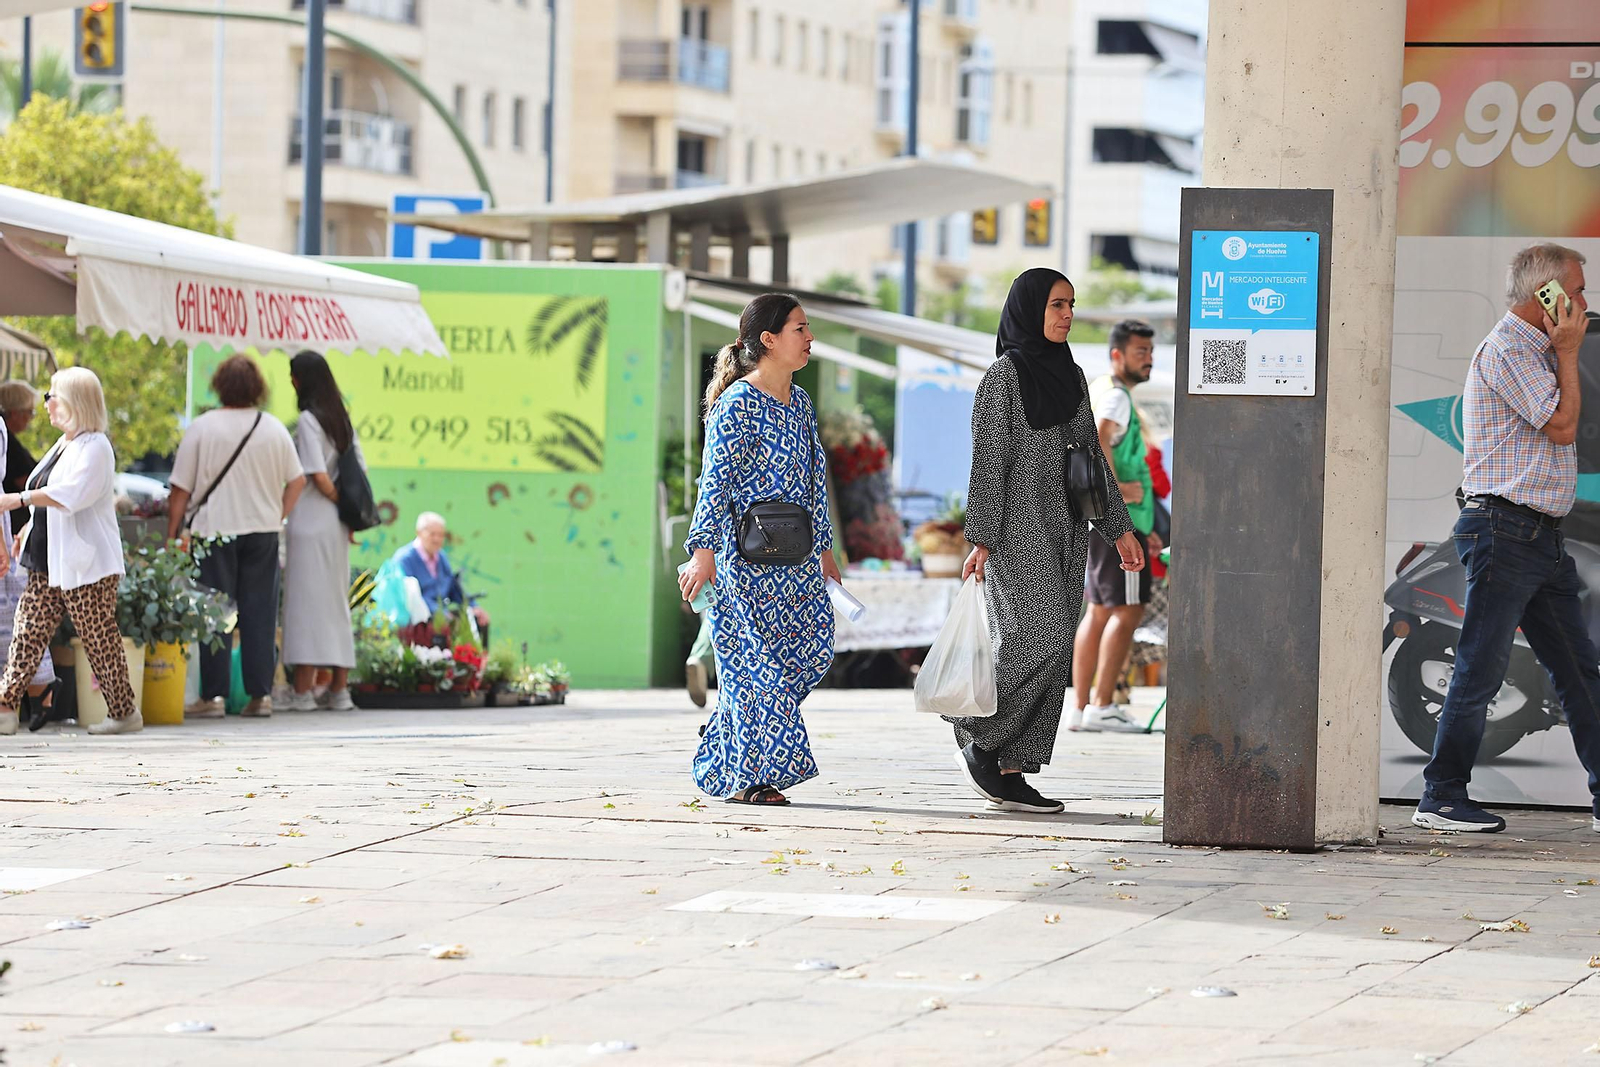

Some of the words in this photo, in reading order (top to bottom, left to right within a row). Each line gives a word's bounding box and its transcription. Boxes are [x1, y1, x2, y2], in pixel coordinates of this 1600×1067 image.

[1569, 62, 1600, 79] D
[413, 198, 462, 260] P
[1247, 242, 1287, 251] Ayuntamiento
[1229, 276, 1264, 284] MERCADO
[1265, 276, 1307, 284] INTELIGENTE
[175, 281, 248, 338] GALLARDO
[255, 289, 359, 342] FLORISTERIA
[383, 365, 464, 392] Manoli
[410, 414, 469, 450] 949
[485, 415, 532, 445] 513
